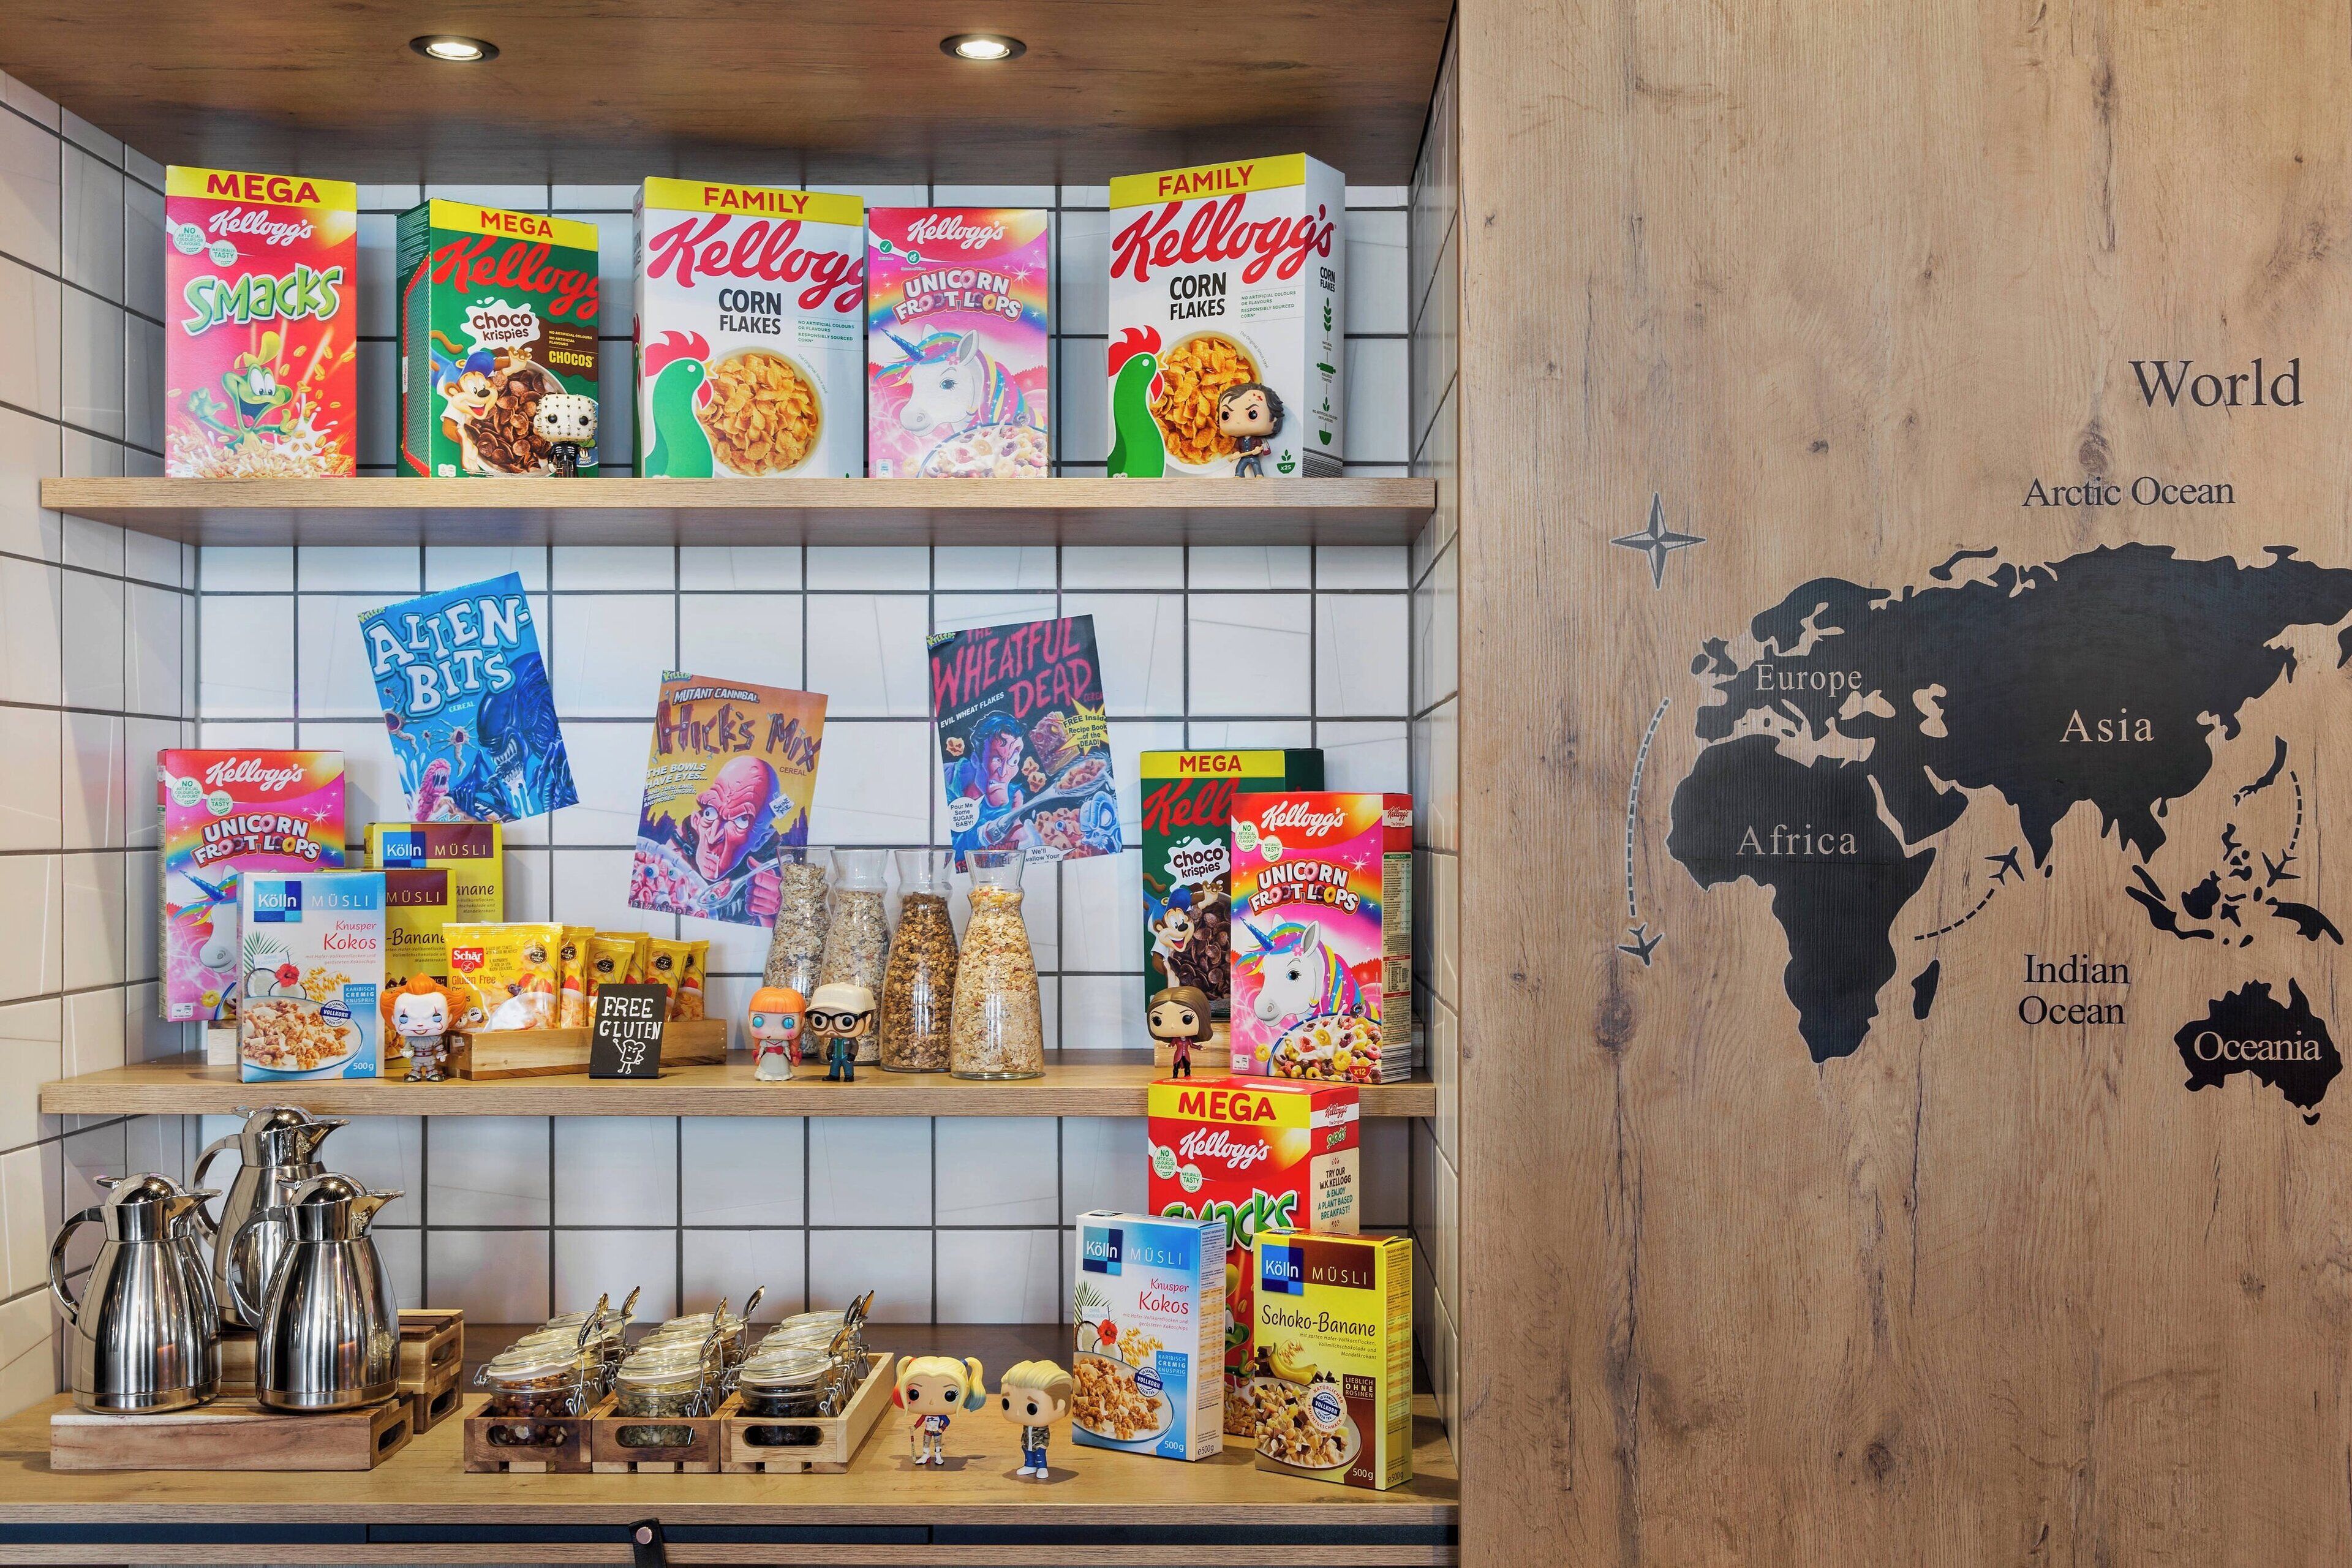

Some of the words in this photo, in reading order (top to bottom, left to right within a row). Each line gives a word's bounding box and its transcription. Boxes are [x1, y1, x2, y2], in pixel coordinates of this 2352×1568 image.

[207, 174, 320, 203] MEGA
[1158, 165, 1254, 197] FAMILY
[704, 187, 809, 214] FAMILY
[209, 207, 314, 246] Kellogg's
[480, 211, 553, 238] MEGA
[907, 214, 1006, 249] Kellogg's
[1110, 192, 1335, 284] Kellogg's
[1320, 266, 1335, 280] CORN
[905, 270, 1010, 299] UNICORN
[1170, 272, 1226, 300] CORN
[1320, 279, 1335, 293] FLAKES
[718, 288, 782, 315] CORN
[1170, 298, 1226, 320] FLAKES
[472, 312, 532, 330] choco
[720, 314, 781, 335] FLAKES
[483, 326, 529, 342] krispies
[549, 350, 592, 368] CHOCOS
[2128, 357, 2304, 408] World
[2021, 477, 2121, 507] Arctic
[2131, 476, 2236, 506] Ocean
[967, 628, 992, 643] THE
[932, 617, 1080, 717] WHEATFUL
[406, 650, 514, 713] BITS
[1008, 658, 1093, 718] DEAD
[1755, 663, 1863, 698] Europe
[673, 688, 713, 704] MUTANT
[714, 688, 760, 703] CANNIBAL
[448, 701, 476, 712] CEREAL
[940, 714, 956, 729] EVIL
[956, 704, 979, 722] WHEAT
[979, 692, 1005, 710] FLAKES
[2059, 707, 2155, 743] Asia
[647, 766, 668, 779] THE
[670, 763, 706, 774] BOWLS
[780, 766, 807, 776] CEREAL
[1179, 755, 1242, 772] MEGA
[206, 757, 303, 791] Kellogg's
[645, 775, 673, 790] HAVE
[675, 772, 707, 782] EYES...
[774, 798, 790, 812] SHINE
[780, 805, 791, 815] ME
[1387, 806, 1408, 821] Kellogg's
[1261, 800, 1346, 837] Kellogg's
[204, 815, 309, 843] UNICORN
[387, 843, 421, 856] Kölln
[435, 843, 486, 856] MÜSLI
[1735, 824, 1858, 856] Africa
[1174, 847, 1224, 869] choco
[1181, 862, 1221, 880] krispies
[1259, 862, 1348, 889] UNICORN
[258, 892, 297, 908] Kölln
[312, 894, 368, 907] MÜSLI
[386, 891, 439, 903] MÜSLI
[336, 921, 377, 932] Knusper
[324, 933, 377, 950] Kokos
[2023, 953, 2131, 984] Indian
[452, 976, 475, 985] Gluten
[480, 975, 496, 984] Free
[323, 1009, 349, 1017] VOLLKORN
[601, 997, 654, 1018] FREE
[2018, 995, 2126, 1025] Ocean
[600, 1020, 663, 1040] GLUTEN
[2193, 1030, 2323, 1061] Oceania
[1178, 1091, 1276, 1121] MEGA
[1325, 1103, 1348, 1118] Kellogg's
[1179, 1128, 1272, 1169] Kellogg's
[1319, 1175, 1351, 1189] W.K.KELLOGG
[1325, 1169, 1335, 1178] TRY
[1336, 1167, 1345, 1175] OUR
[1331, 1187, 1346, 1197] ENJOY
[1322, 1199, 1336, 1210] PLANT
[1338, 1194, 1352, 1205] BASED
[1321, 1206, 1350, 1220] BREAKFAST!
[1087, 1240, 1117, 1259] Kölln
[1130, 1248, 1182, 1265] MÜSLI
[1265, 1260, 1298, 1278] Kölln
[1312, 1266, 1366, 1284] MÜSLI
[1151, 1278, 1189, 1294] Knusper
[1139, 1291, 1189, 1314] Kokos
[1131, 1313, 1178, 1323] Hafer-Vollkornflocken
[1261, 1304, 1376, 1336] Schoko-Banane
[1318, 1342, 1366, 1352] Vollmilchschokolade
[1341, 1351, 1376, 1360] Mandelkrokant
[1137, 1376, 1160, 1388] VOLLKORN
[1345, 1377, 1373, 1385] LIEBLICH
[1345, 1384, 1373, 1392] OHNE
[1313, 1384, 1344, 1404] NATÜRLICHER
[1314, 1401, 1338, 1414] VOLLKORN
[1317, 1411, 1325, 1420] JEDEN
